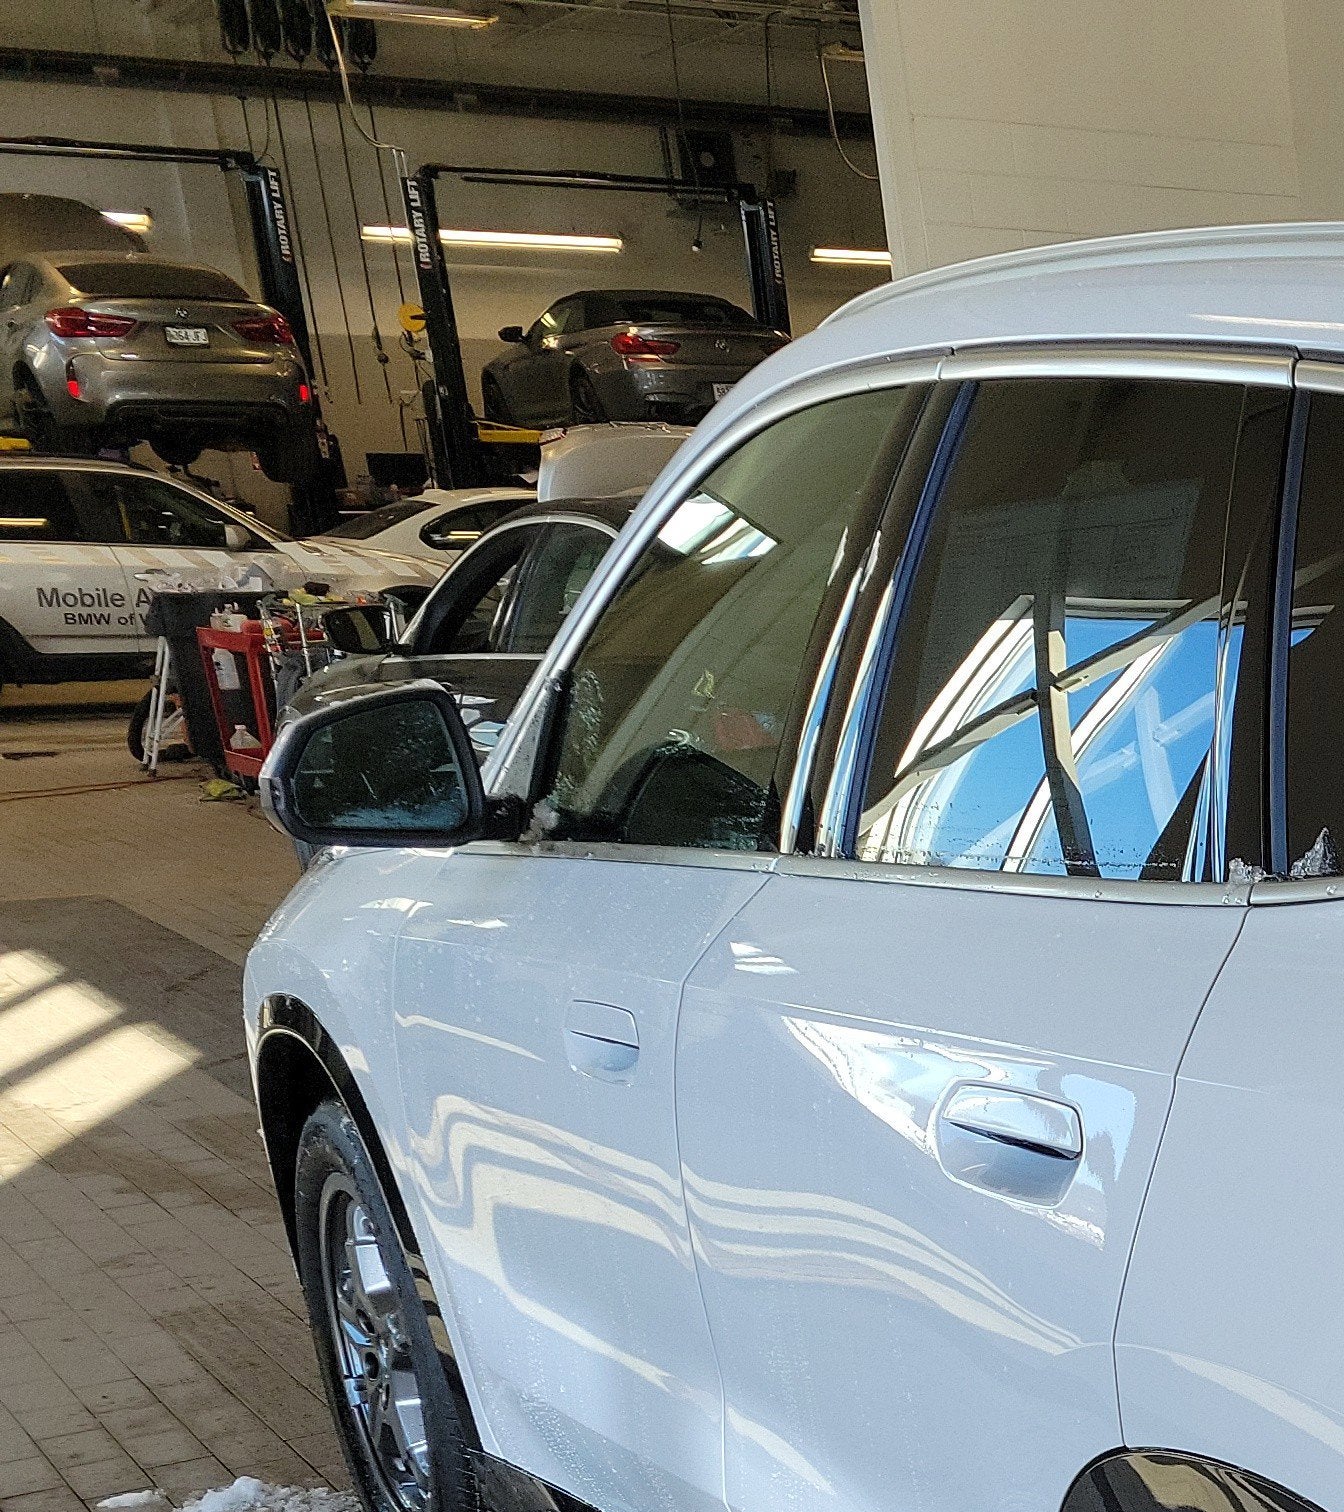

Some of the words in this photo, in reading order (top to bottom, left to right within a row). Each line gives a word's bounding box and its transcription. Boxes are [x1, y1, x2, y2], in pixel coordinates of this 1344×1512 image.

[267, 169, 281, 198] LIFT
[406, 179, 421, 207] LIFT
[272, 200, 291, 255] ROTARY
[411, 209, 431, 262] ROTARY
[770, 228, 782, 278] ROTARY
[36, 587, 126, 608] Mobile
[63, 612, 111, 626] BMW
[117, 612, 135, 626] of
